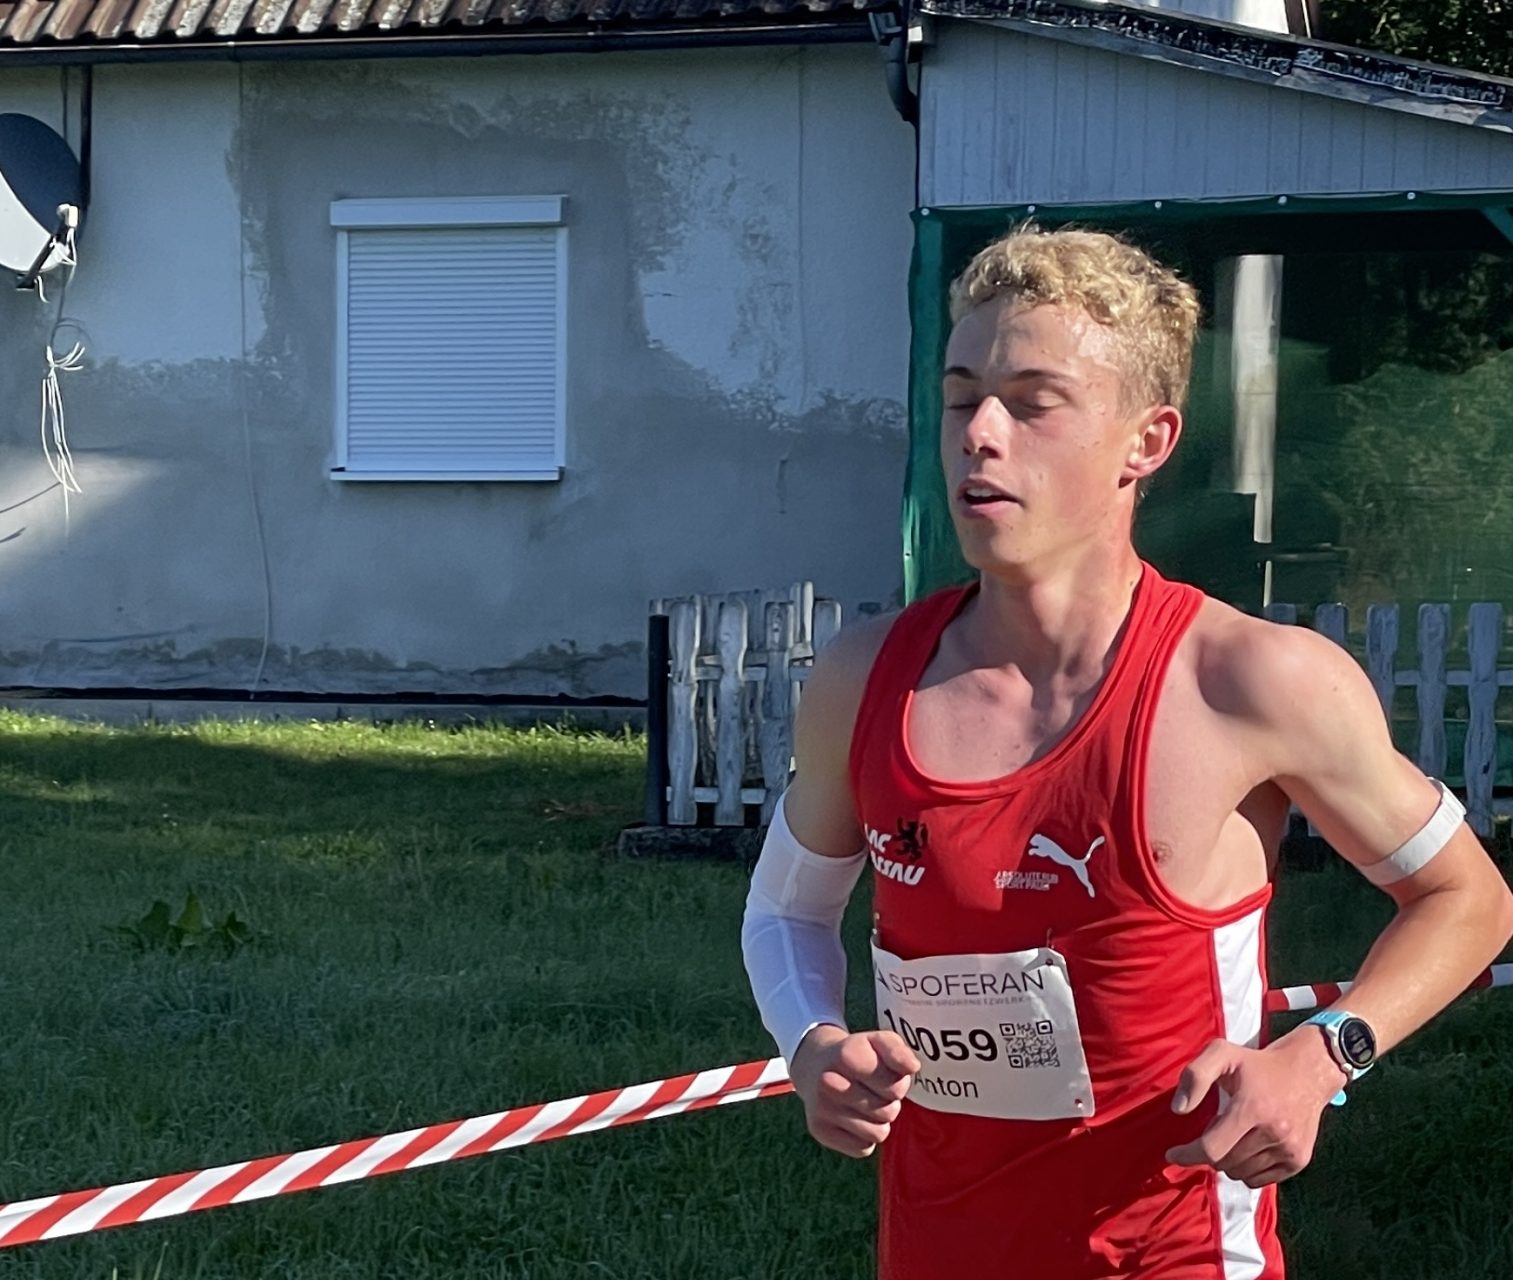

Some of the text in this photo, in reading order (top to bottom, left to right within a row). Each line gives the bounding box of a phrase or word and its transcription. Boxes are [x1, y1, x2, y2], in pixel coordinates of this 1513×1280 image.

[889, 969, 1044, 997] SPOFERAN
[884, 1008, 998, 1062] 10059
[914, 1072, 979, 1099] Anton
